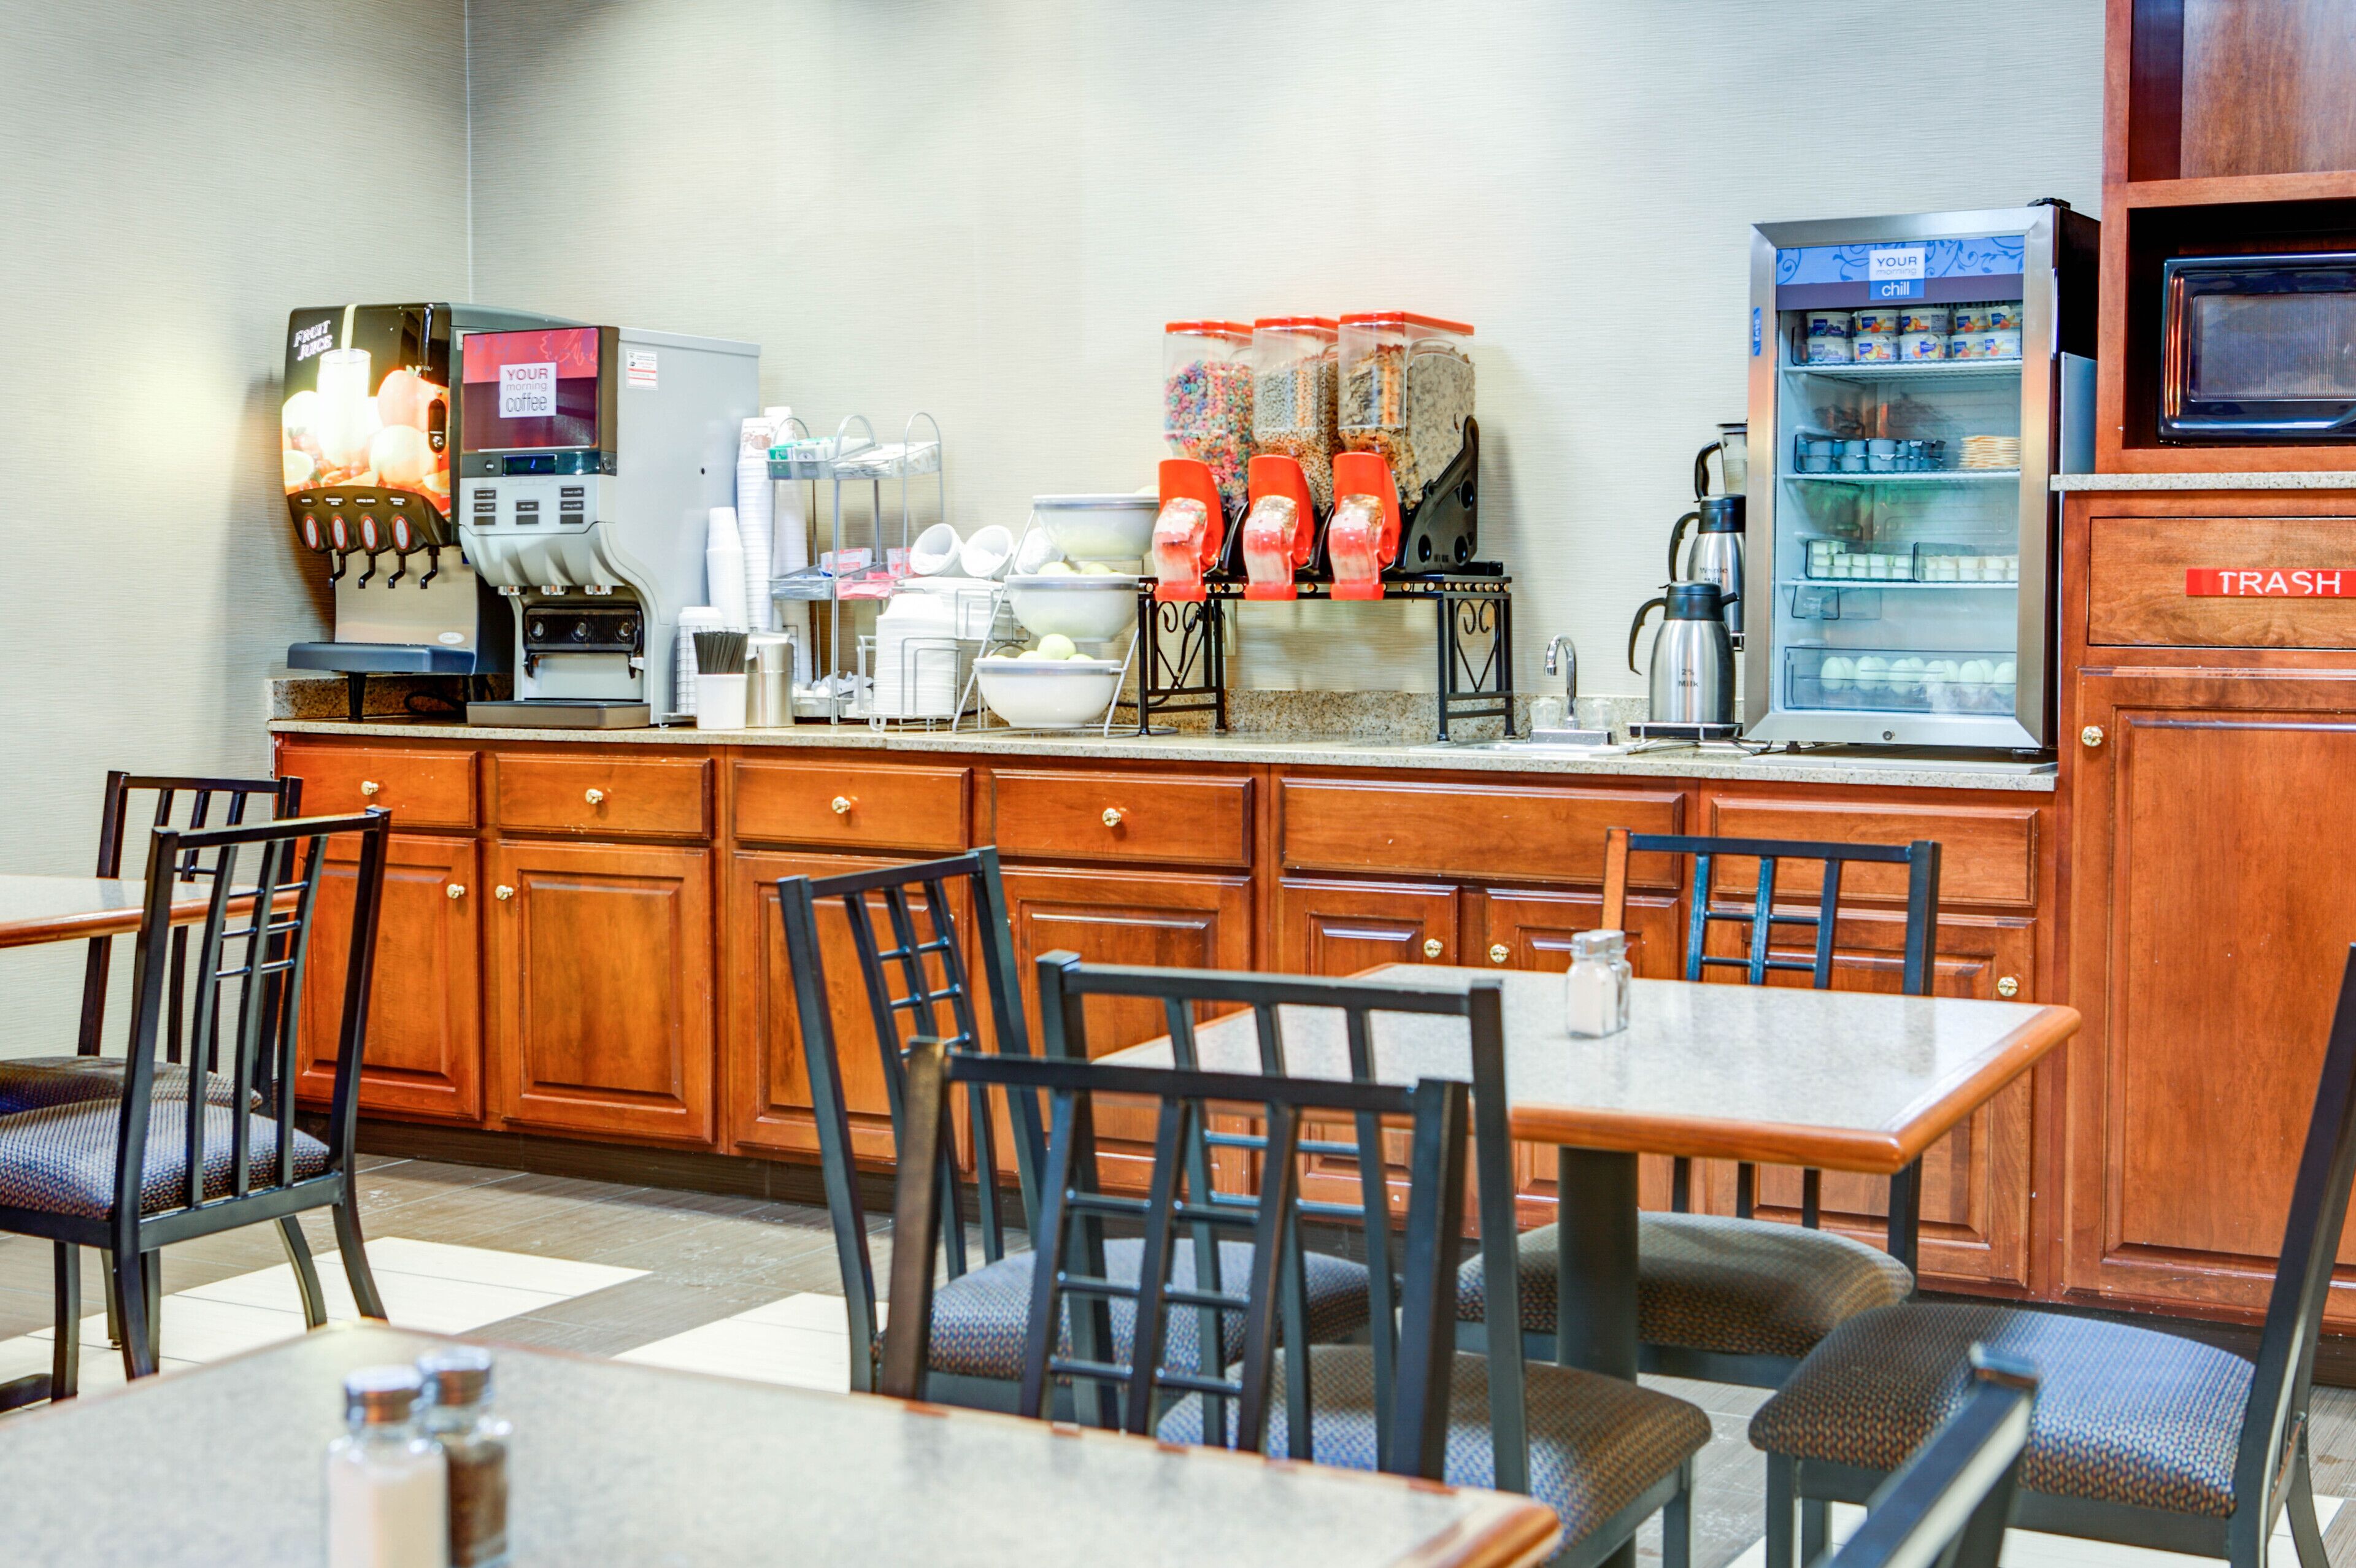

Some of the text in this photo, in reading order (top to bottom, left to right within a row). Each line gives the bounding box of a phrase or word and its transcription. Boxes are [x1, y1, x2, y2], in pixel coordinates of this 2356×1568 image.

[1877, 256, 1917, 267] YOUR
[1876, 267, 1917, 276] morning
[1881, 281, 1910, 297] chill
[506, 368, 549, 380] YOUR
[506, 382, 547, 392] morning
[506, 392, 548, 412] coffee
[2218, 571, 2341, 596] TRASH
